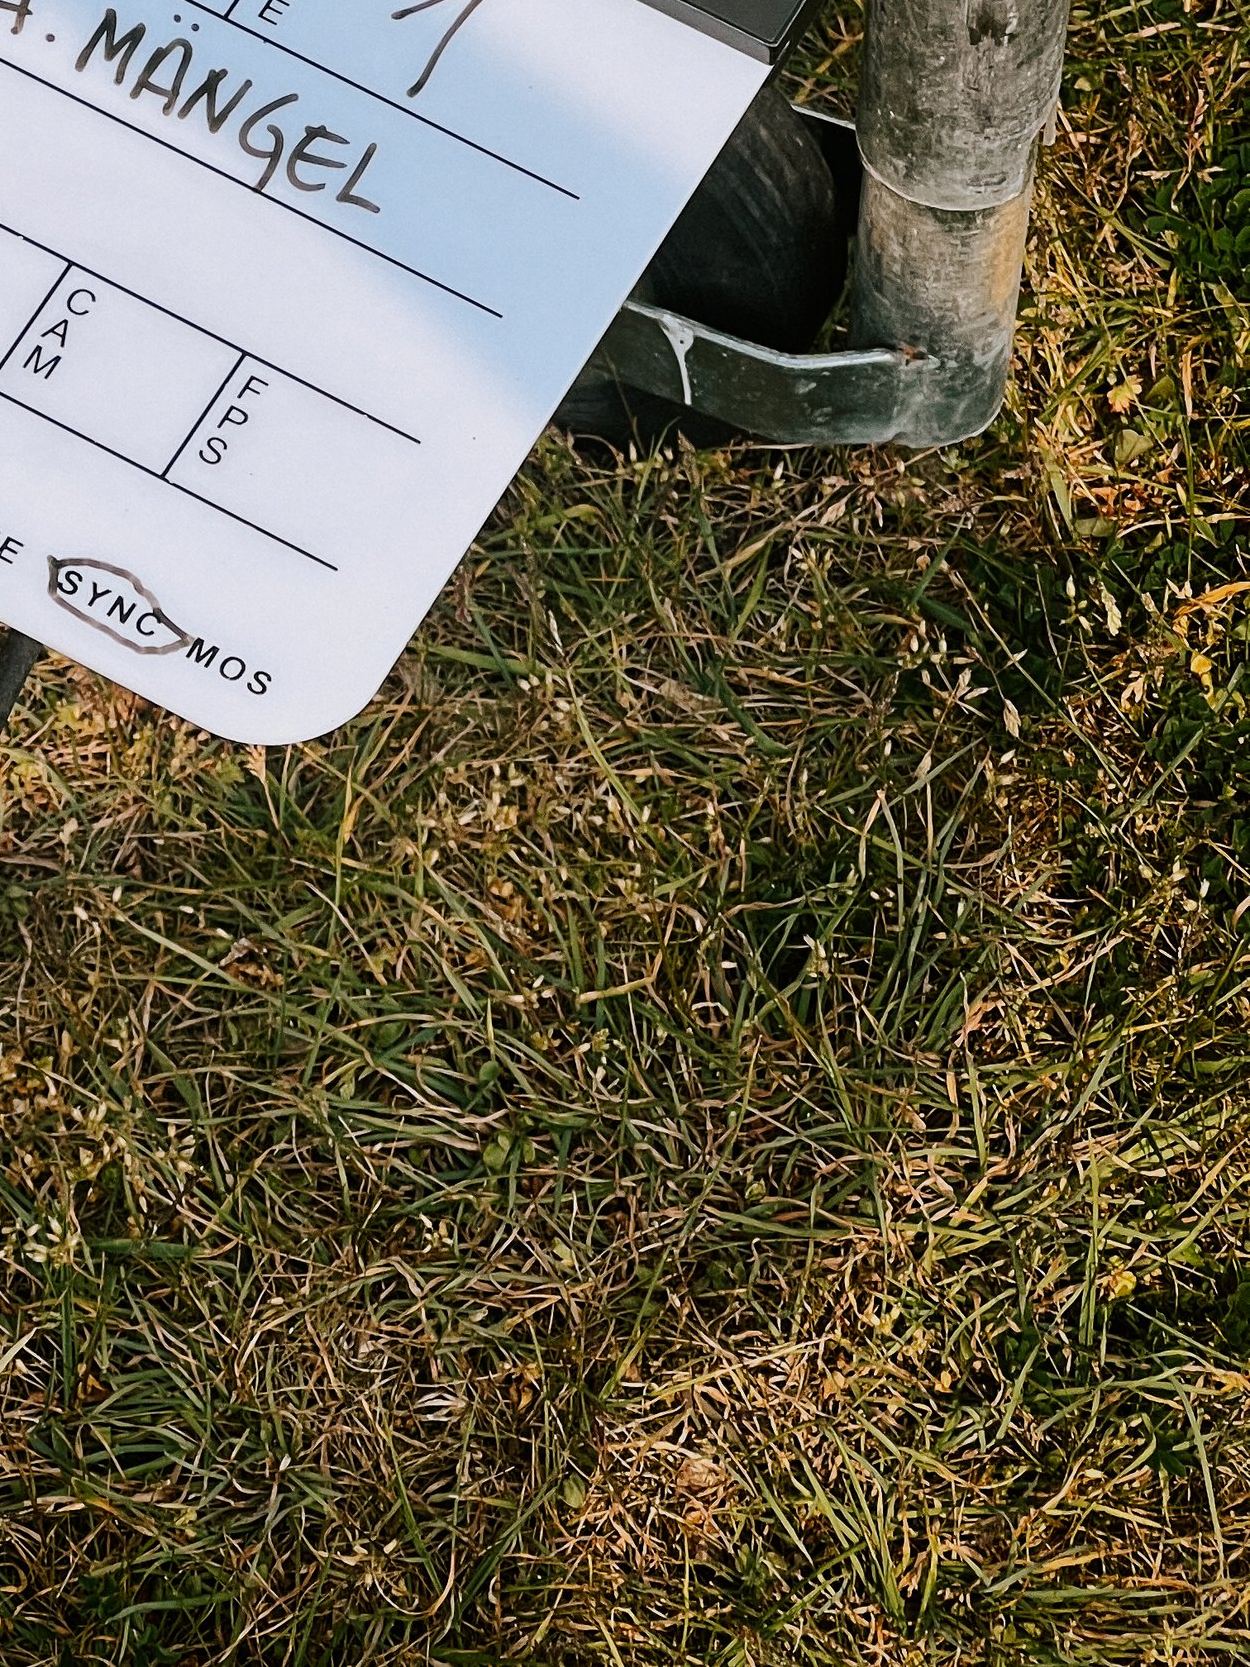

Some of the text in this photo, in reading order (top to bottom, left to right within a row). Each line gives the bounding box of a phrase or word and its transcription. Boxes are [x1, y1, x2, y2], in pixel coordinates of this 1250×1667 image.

[75, 8, 381, 213] MÄNGEL
[24, 288, 96, 380] CAM
[198, 375, 269, 465] FPS
[55, 570, 161, 638] SYNC
[185, 637, 272, 695] MOS
